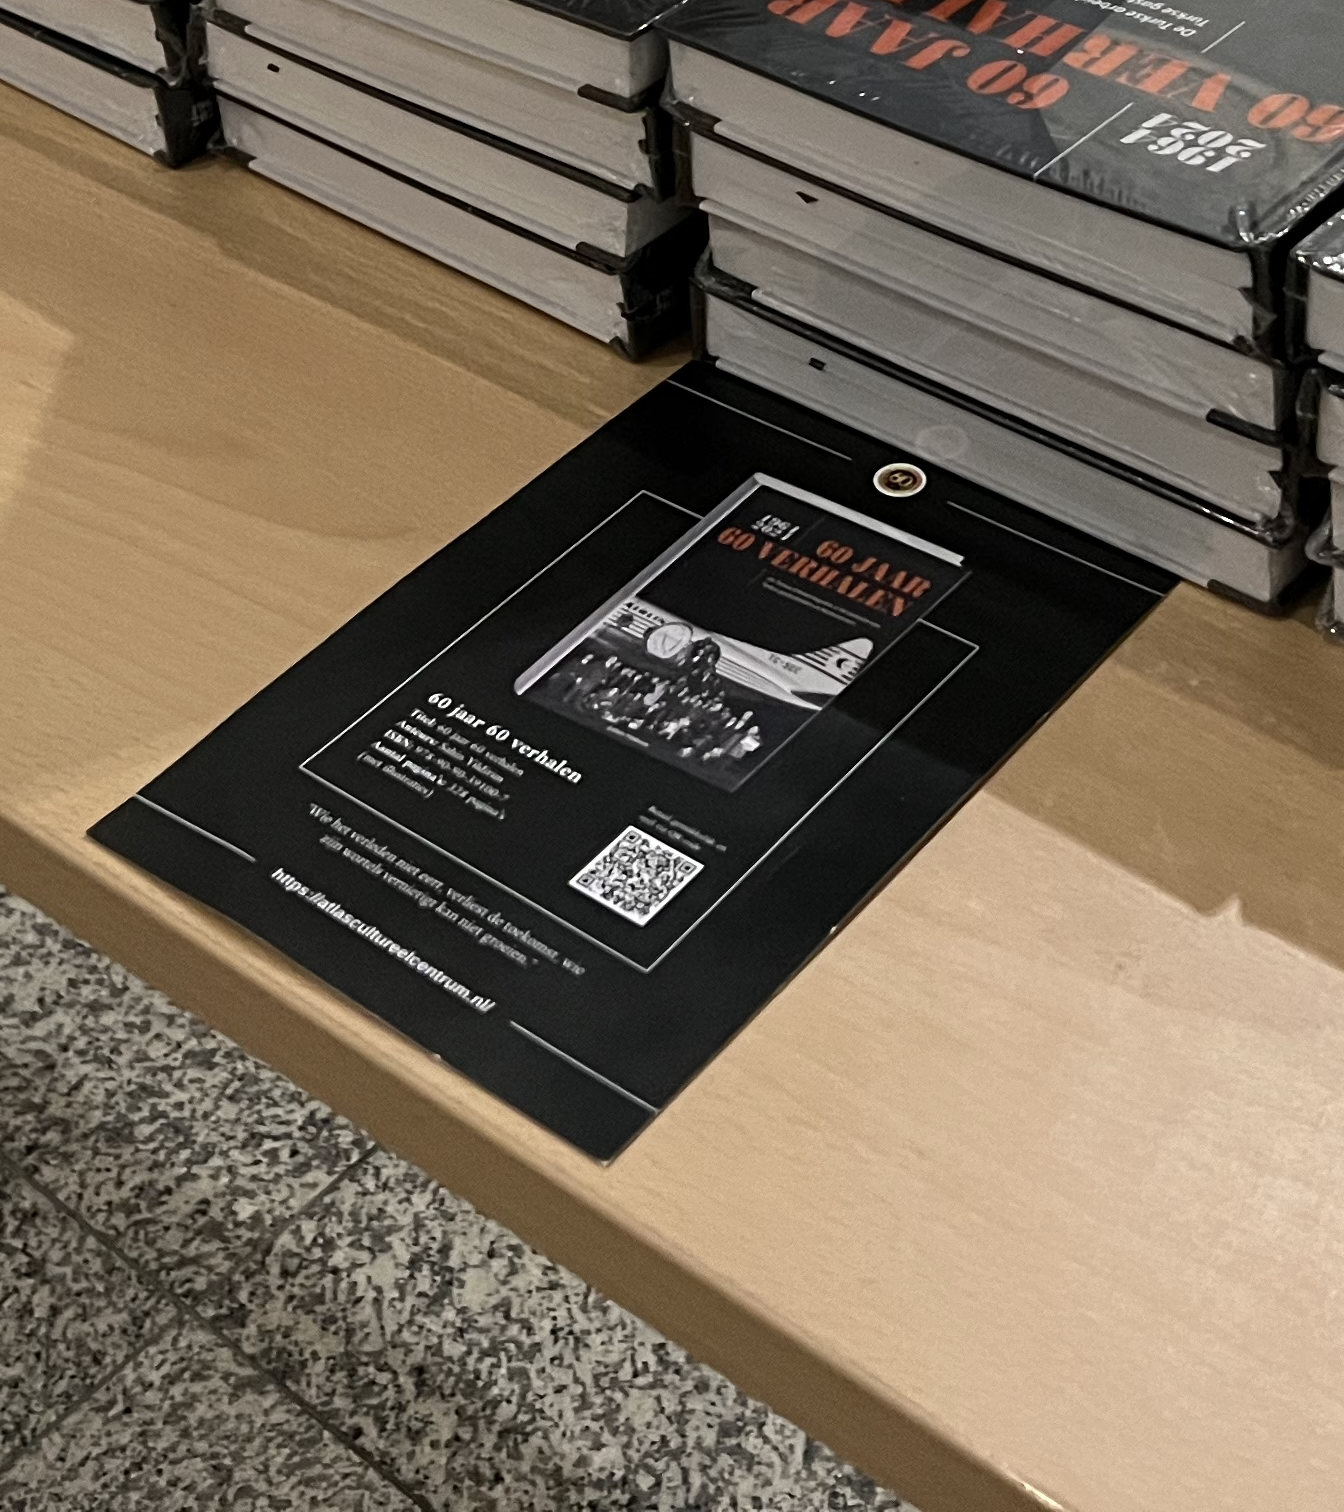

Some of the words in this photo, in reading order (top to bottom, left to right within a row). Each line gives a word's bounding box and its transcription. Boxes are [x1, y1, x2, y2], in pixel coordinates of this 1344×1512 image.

[1124, 11, 1174, 31] Turkse
[1161, 7, 1210, 28] Turkse
[1173, 24, 1197, 38] De
[966, 60, 1070, 110] 60
[1119, 128, 1240, 173] 1964
[1141, 112, 1267, 159] 2024
[718, 526, 756, 552] 60
[758, 540, 911, 618] VERHALEN
[816, 539, 855, 565] 60
[850, 555, 933, 600] JAAR
[427, 692, 454, 710] 60
[445, 704, 487, 729] jaar
[485, 724, 511, 742] 60
[511, 738, 584, 785] verhalen
[350, 830, 398, 864] verleden
[486, 911, 506, 927] de
[270, 867, 498, 1014] https://atlascultureelcentrum.nl/
[433, 900, 459, 924] kan
[457, 917, 485, 938] niet
